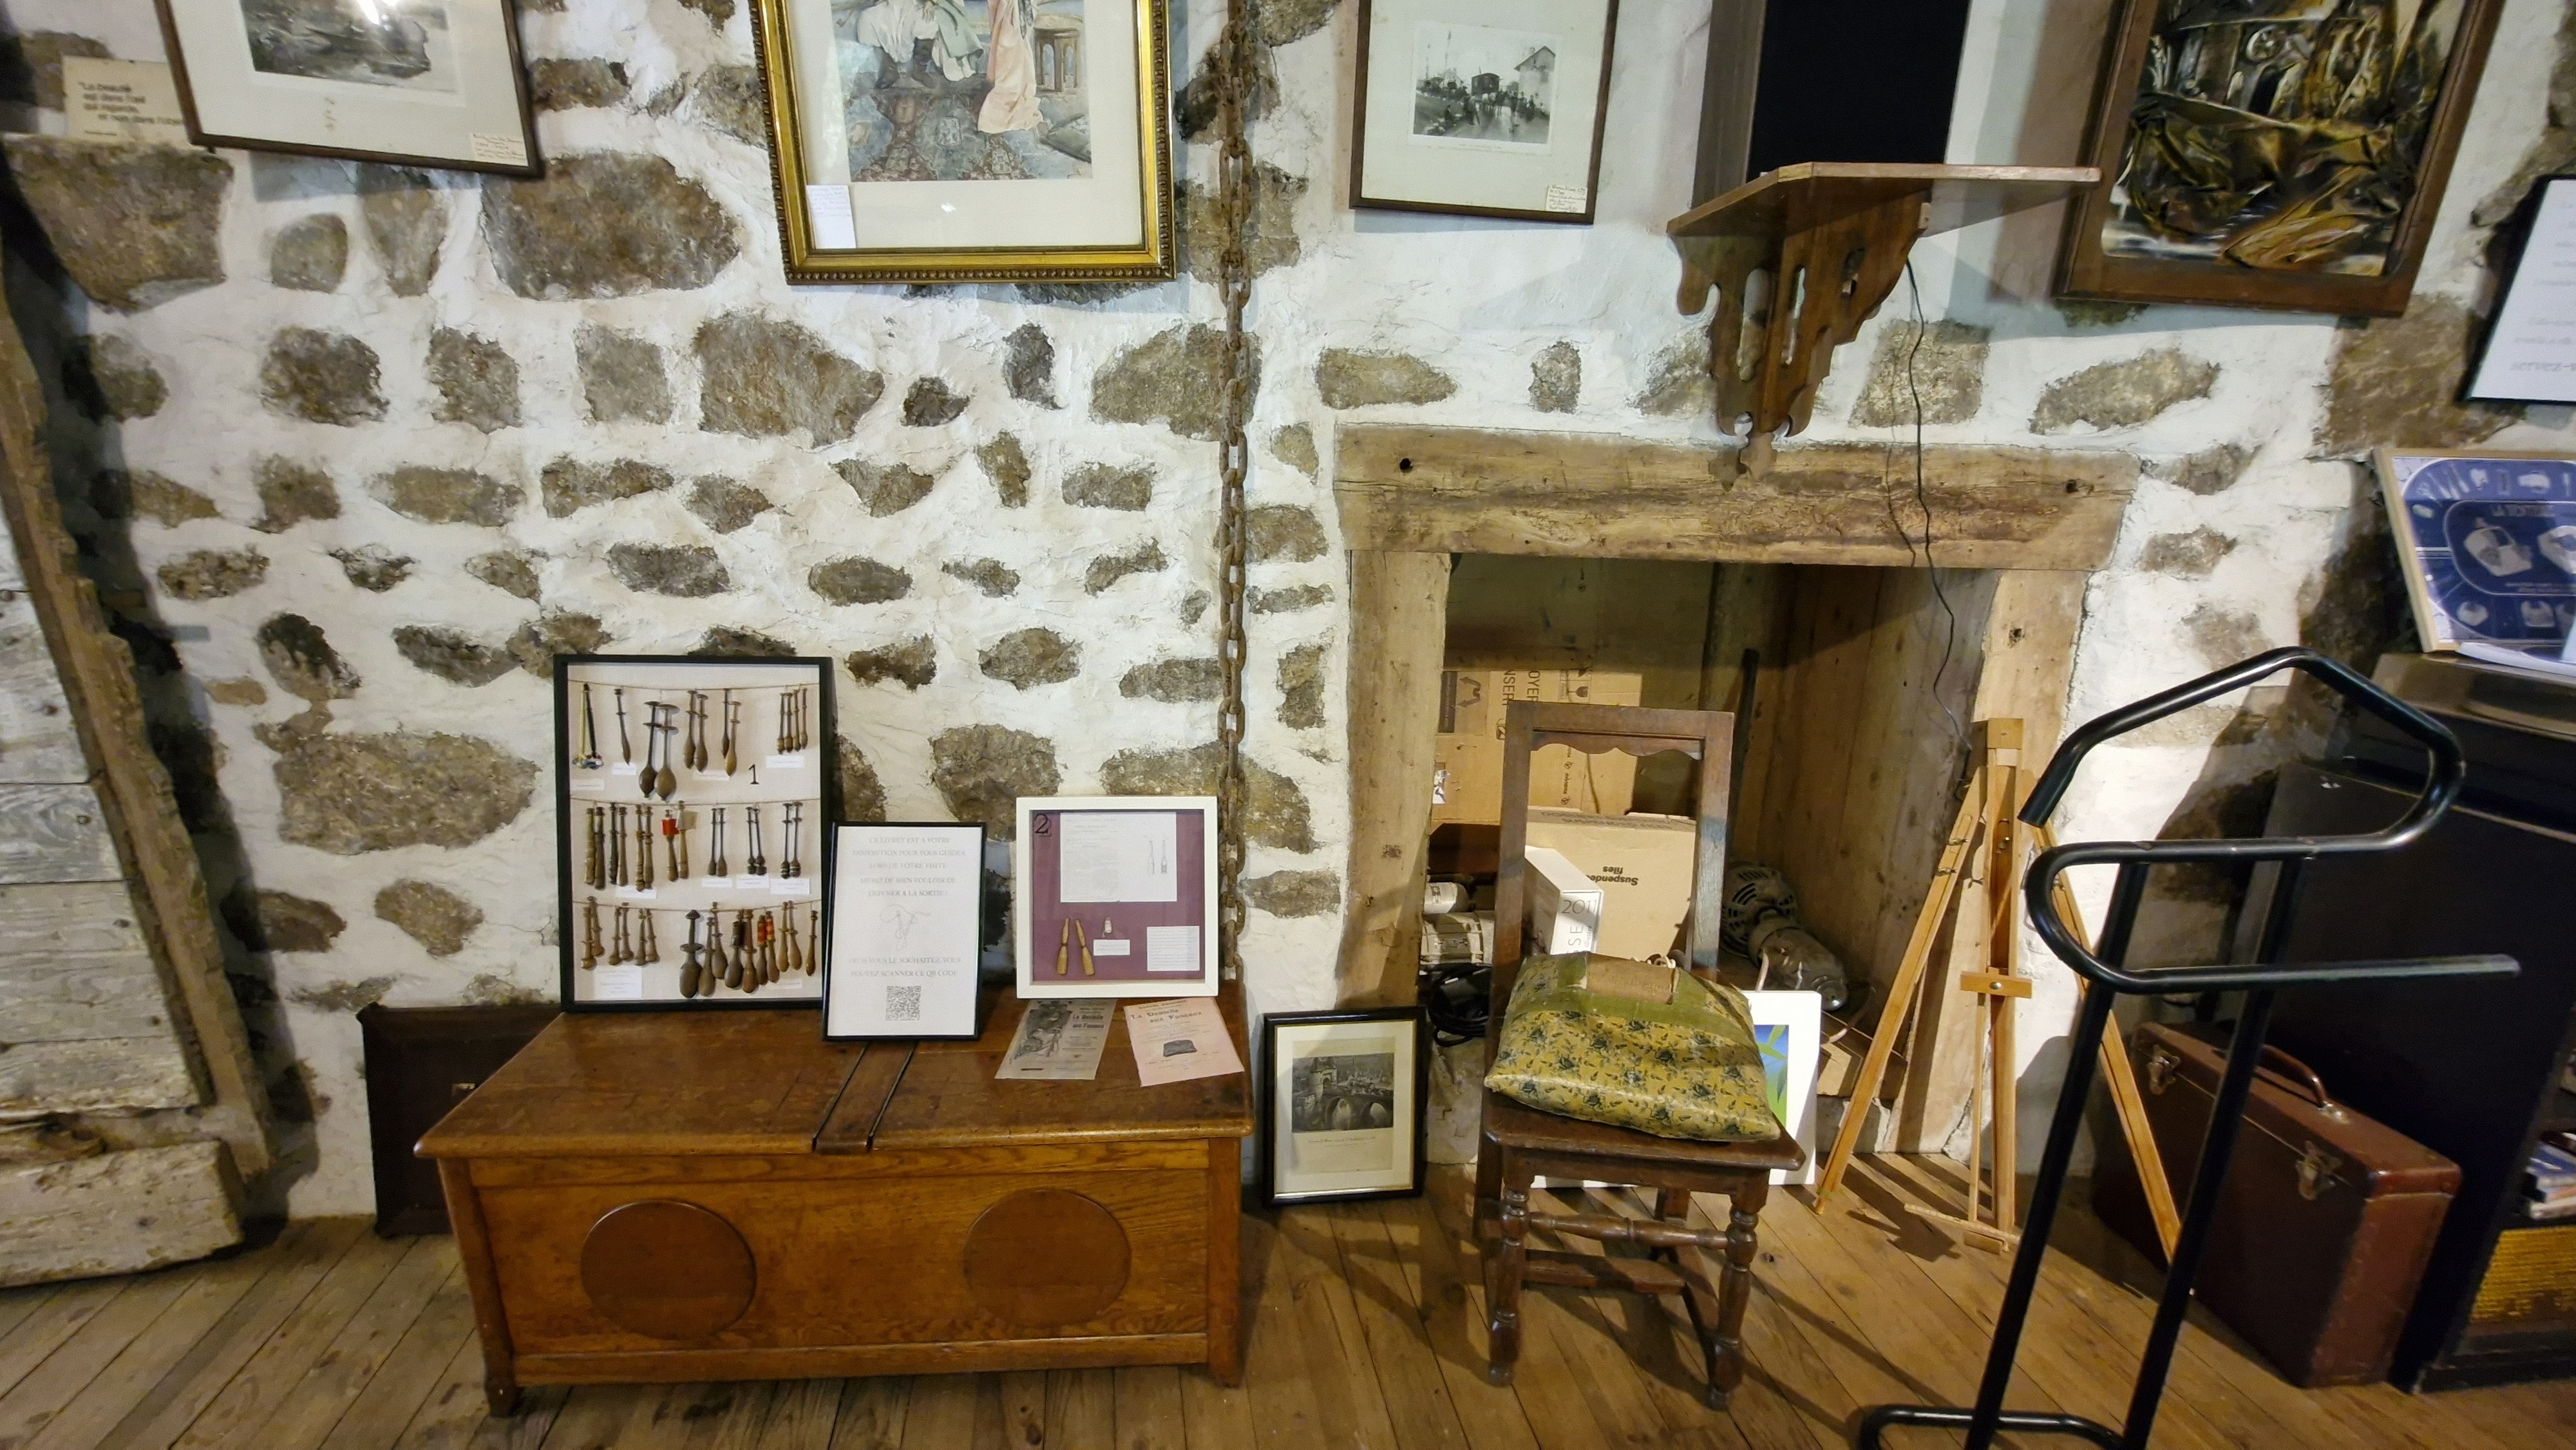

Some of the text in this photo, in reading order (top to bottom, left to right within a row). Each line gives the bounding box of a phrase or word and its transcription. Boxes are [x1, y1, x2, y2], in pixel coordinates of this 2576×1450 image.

[748, 764, 759, 784] 1
[1034, 814, 1048, 834] 2
[1602, 866, 1624, 874] files
[1586, 874, 1639, 886] Suspende
